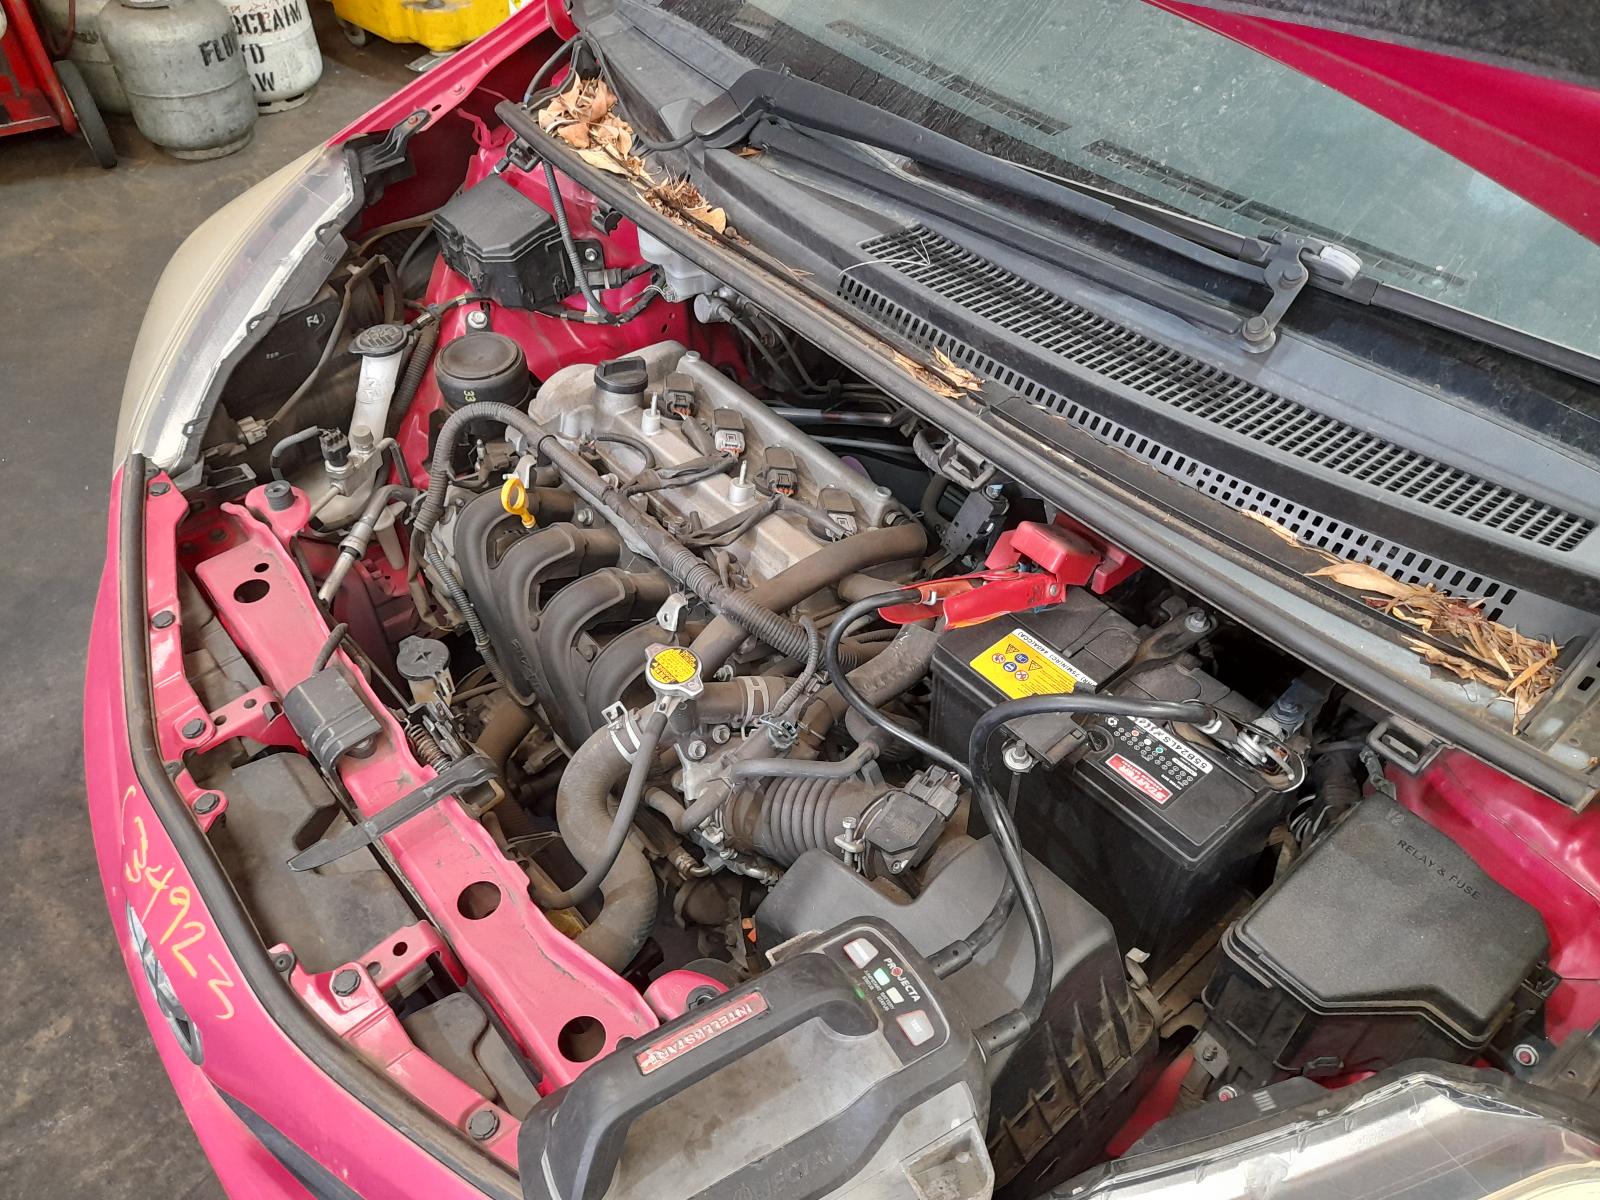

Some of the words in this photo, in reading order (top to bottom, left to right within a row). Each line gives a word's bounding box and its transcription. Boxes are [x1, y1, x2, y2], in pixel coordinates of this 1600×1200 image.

[1161, 735, 1209, 769] 55B24LS
[1397, 839, 1435, 868] RELAY
[1437, 867, 1447, 877] &
[1448, 874, 1481, 900] FUSE
